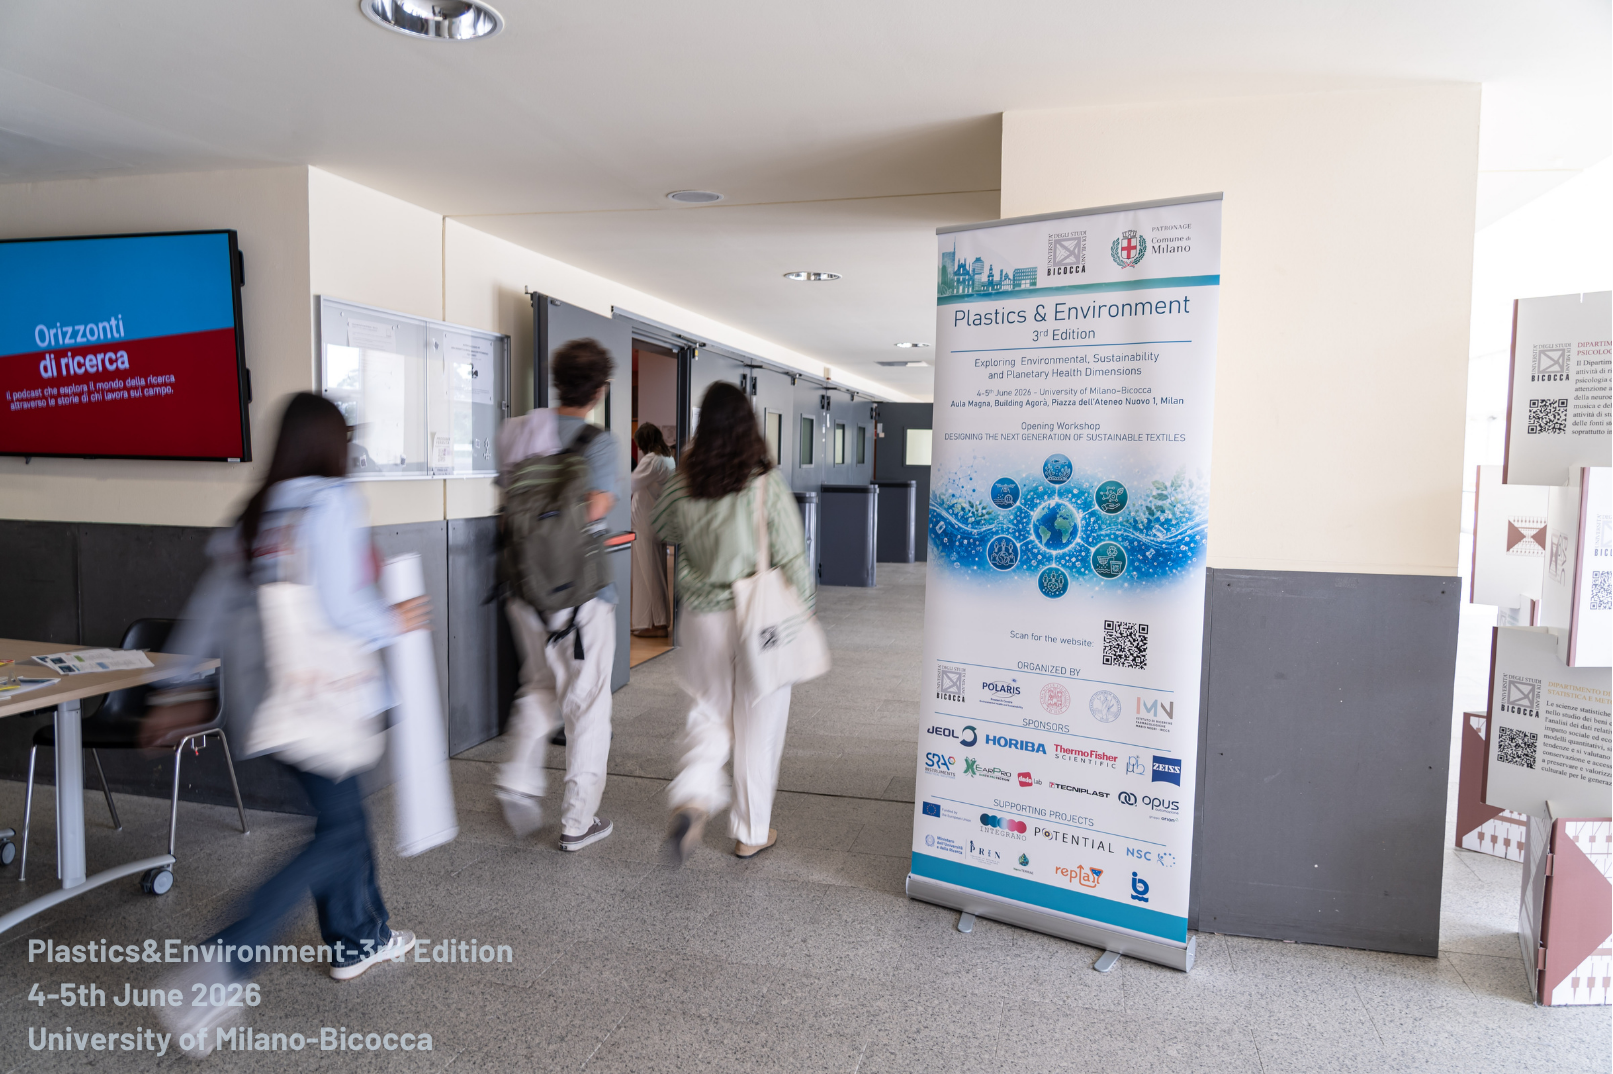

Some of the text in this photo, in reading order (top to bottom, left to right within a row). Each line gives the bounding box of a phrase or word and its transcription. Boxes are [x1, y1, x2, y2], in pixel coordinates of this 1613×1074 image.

[1152, 223, 1192, 232] PATRONAGE
[1152, 236, 1184, 244] Comune
[1152, 244, 1191, 254] Milano
[1047, 265, 1086, 276] BICOCCA
[954, 296, 1190, 328] Plastics & Environment
[34, 314, 125, 348] Orizzonti
[1032, 328, 1096, 342] 3rd Edition
[40, 350, 130, 379] di ricerca
[974, 352, 1160, 369] Exploring Environmental, Sustainability
[988, 366, 1142, 380] and Planetary Health Dimensions
[1532, 374, 1570, 382] BICOCCA
[1574, 376, 1608, 384] psicologia
[13, 374, 176, 402] podcast che esplora mondo della ricerca
[995, 388, 1012, 397] June
[1014, 388, 1032, 396] 2026
[1040, 387, 1078, 397] University
[1080, 386, 1088, 395] of
[1090, 386, 1152, 394] Milano-Bicocca
[10, 398, 47, 412] attraverso
[48, 396, 56, 407] le
[57, 394, 80, 406] storie
[82, 392, 89, 404] di
[90, 390, 103, 402] chi
[104, 388, 129, 401] lavora
[130, 386, 143, 398] sul
[968, 400, 993, 408] Magna,
[994, 399, 1024, 408] Building
[1025, 398, 1050, 408] Agorà,
[1078, 398, 1122, 406] dell'Ateneo
[1125, 398, 1150, 406] Nuovo
[1152, 396, 1158, 406] 1,
[1160, 396, 1184, 405] Milan
[1021, 422, 1101, 432] Opening Workshop
[944, 432, 983, 440] DESIGNING
[984, 432, 998, 440] THE
[1000, 432, 1020, 440] NEXT
[1073, 433, 1084, 441] OF
[1086, 433, 1144, 442] SUSTAINABLE
[1146, 433, 1186, 442] TEXTILES
[1010, 630, 1095, 648] Scan for the website:
[1017, 660, 1082, 677] ORGANIZED BY
[982, 682, 1021, 696] POLARIS
[1548, 681, 1602, 695] DIPARTIMENTO
[1548, 688, 1587, 701] STATISTICA
[936, 692, 966, 703] BICOCCA
[1136, 696, 1174, 720] IMN
[1501, 704, 1540, 718] BICOCCA
[1556, 702, 1578, 712] scienze
[1580, 706, 1612, 718] statistiche
[1022, 718, 1070, 733] SPONSORS
[1562, 712, 1581, 720] studio
[1594, 718, 1608, 726] beni
[926, 726, 960, 739] JEOL
[1544, 725, 1568, 735] impatto
[1568, 730, 1590, 740] sociale
[1580, 724, 1592, 732] dati
[985, 734, 1046, 754] HORIBA
[1544, 733, 1606, 751] modelli quantitativi,
[1542, 750, 1586, 764] conservazione
[1543, 742, 1570, 752] tendenze
[1583, 750, 1611, 760] valutano
[925, 752, 950, 771] SRA
[1054, 754, 1116, 770] SCIENTIFIC
[1153, 762, 1180, 774] ZEISS
[1546, 758, 1578, 770] preservare
[924, 766, 956, 777] INSTRUMENTS
[1541, 766, 1568, 776] culturale
[1568, 771, 1580, 779] per
[1054, 783, 1110, 798] TECNIPLAST
[1142, 795, 1180, 810] opus
[993, 798, 1094, 827] SUPPORTING PROJECTS
[980, 826, 1026, 842] INTEGRANO
[1034, 826, 1115, 854] POTENTIAL
[1126, 846, 1152, 861] NSC
